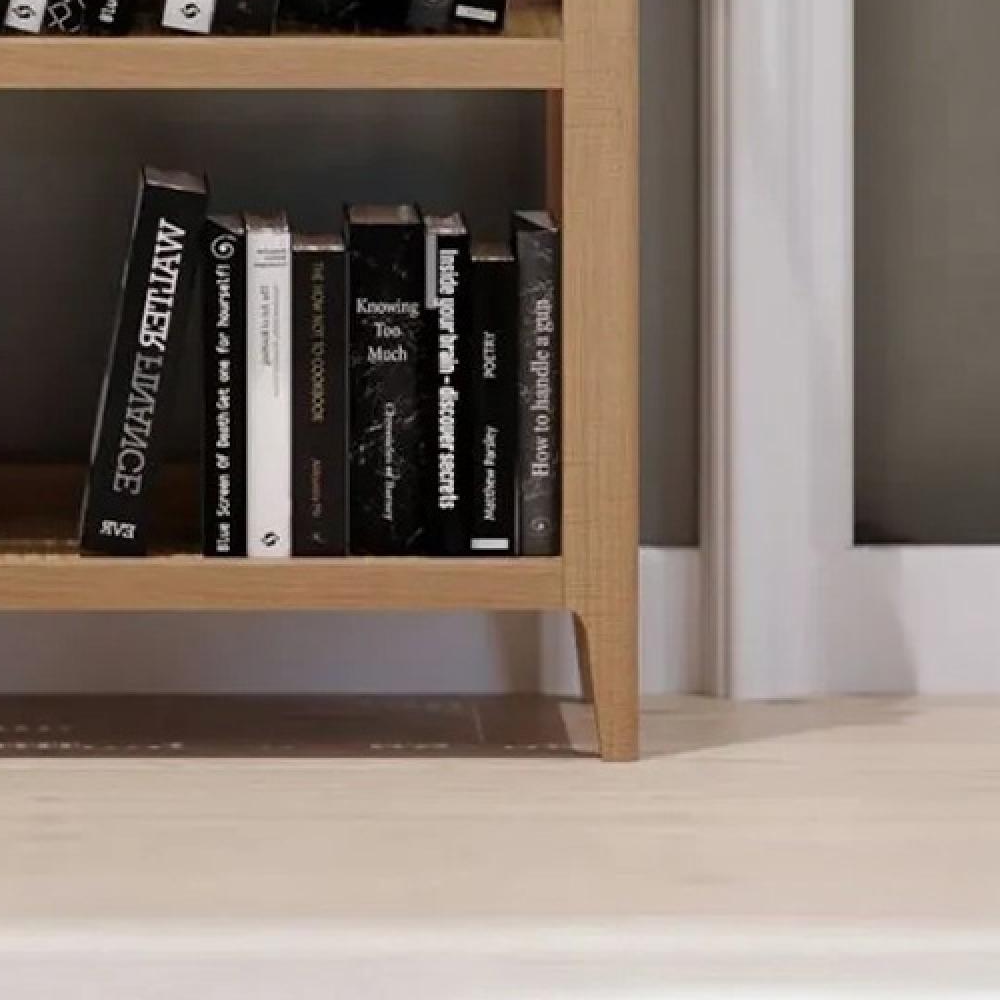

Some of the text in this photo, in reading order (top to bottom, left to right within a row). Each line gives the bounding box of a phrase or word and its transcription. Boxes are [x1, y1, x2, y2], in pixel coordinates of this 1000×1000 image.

[439, 249, 459, 295] Inside
[356, 297, 420, 317] Knowing
[435, 297, 455, 335] your
[215, 331, 231, 355] for
[374, 321, 400, 338] Too
[219, 359, 231, 383] one
[367, 345, 408, 363] Much
[439, 332, 459, 375] brain
[483, 331, 497, 379] POETRY
[529, 297, 555, 479] How to handle a gun
[215, 411, 231, 449] Death
[439, 385, 459, 453] discover
[215, 473, 231, 517] Screen
[439, 450, 459, 509] secrets
